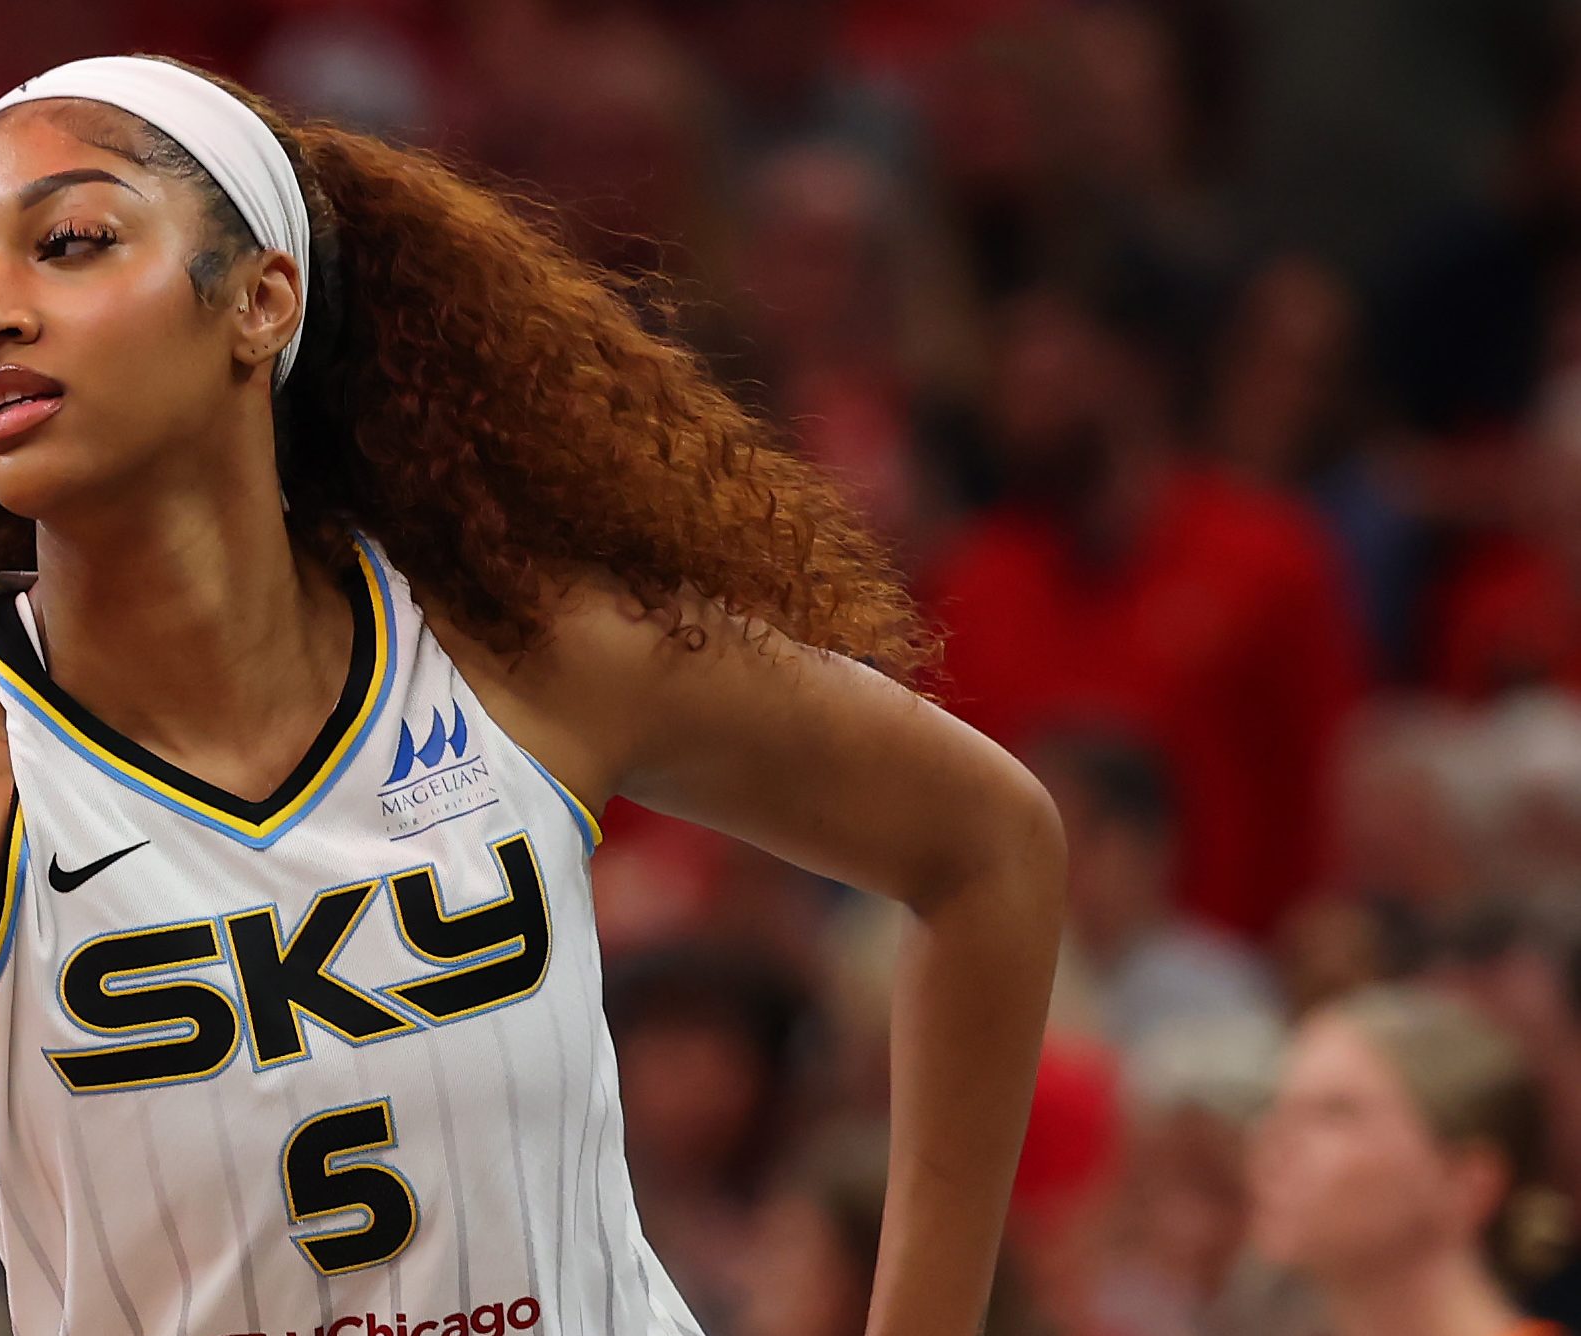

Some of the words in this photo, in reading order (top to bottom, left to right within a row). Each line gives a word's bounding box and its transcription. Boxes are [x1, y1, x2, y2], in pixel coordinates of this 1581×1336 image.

[381, 760, 490, 818] MAGELLAN
[41, 829, 554, 1095] SKY
[281, 1096, 421, 1278] 5
